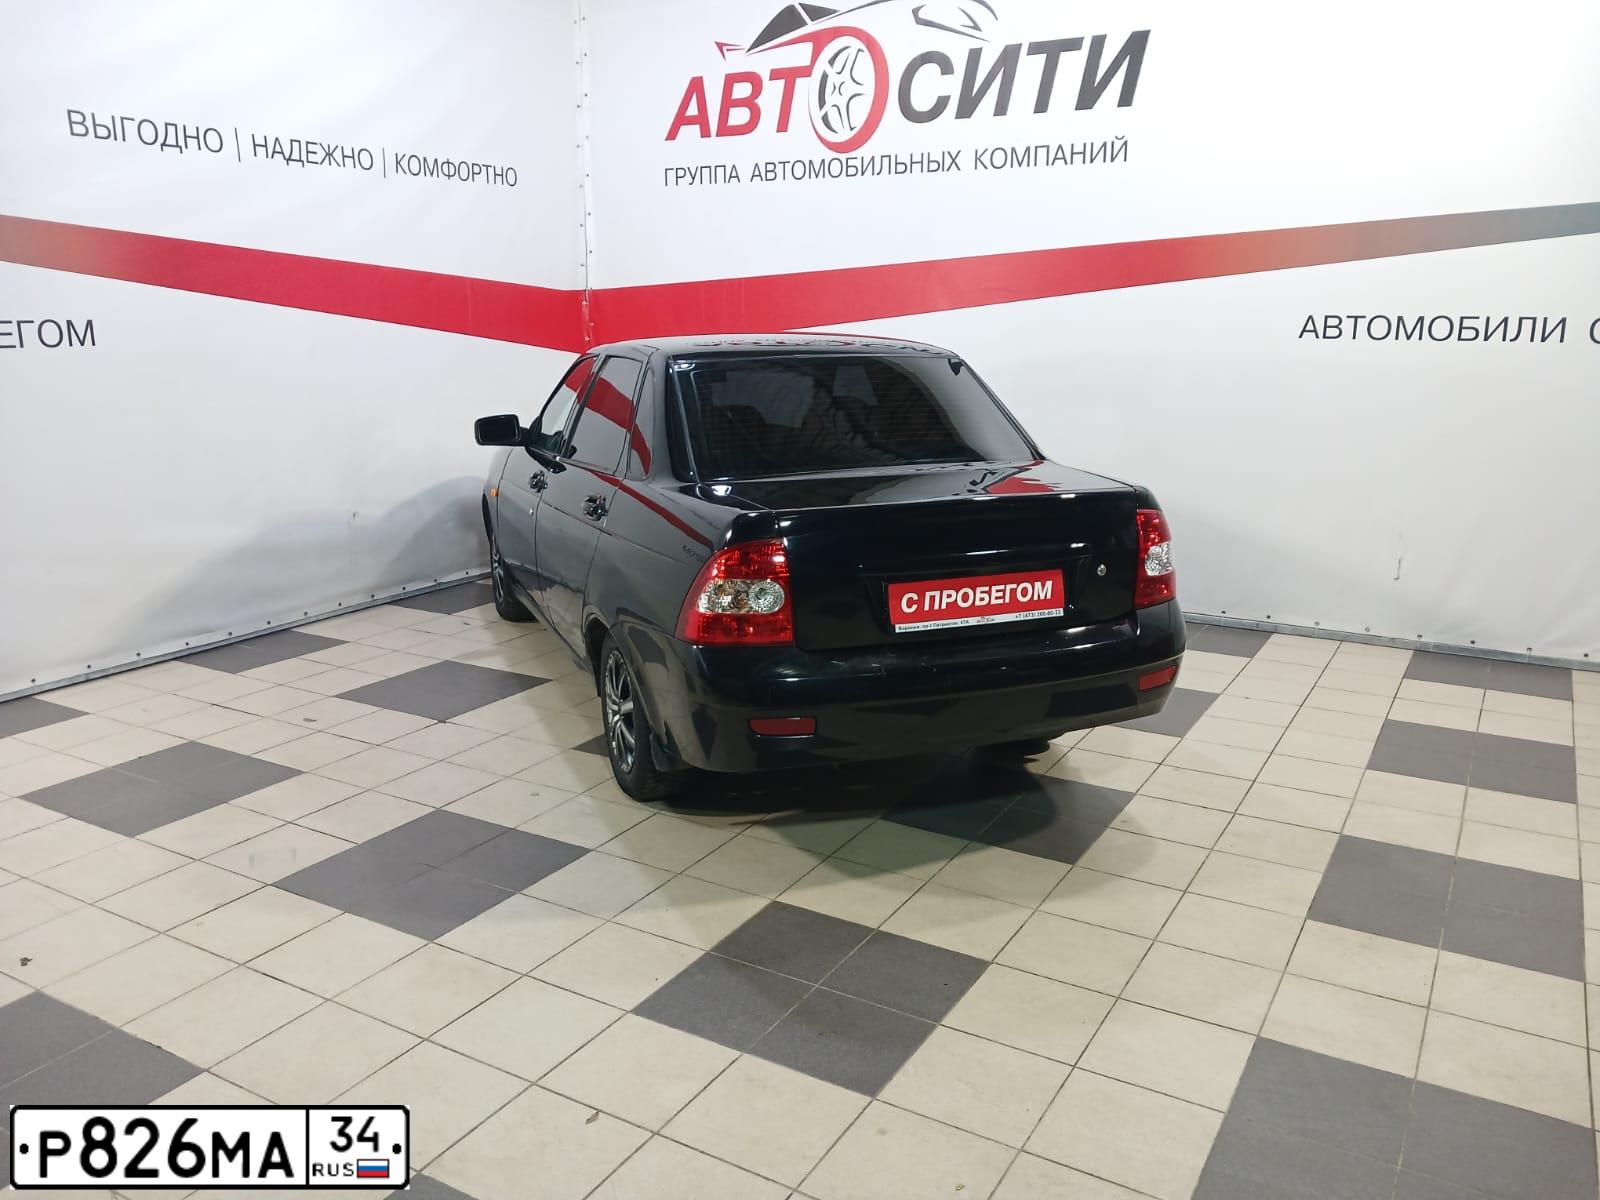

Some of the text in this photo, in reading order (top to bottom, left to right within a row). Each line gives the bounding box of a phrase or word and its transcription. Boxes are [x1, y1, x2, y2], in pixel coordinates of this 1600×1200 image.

[67, 109, 518, 188] ВЫГОДНО НАДЕЖНО КОМФОРТНО
[664, 136, 1129, 187] ГРУППА АВТОМОБИЛЬНЫХ КОМПАНИЙ
[1297, 314, 1568, 344] АВТОМОБИЛИ
[901, 580, 1053, 613] С ПРОБЕГОМ
